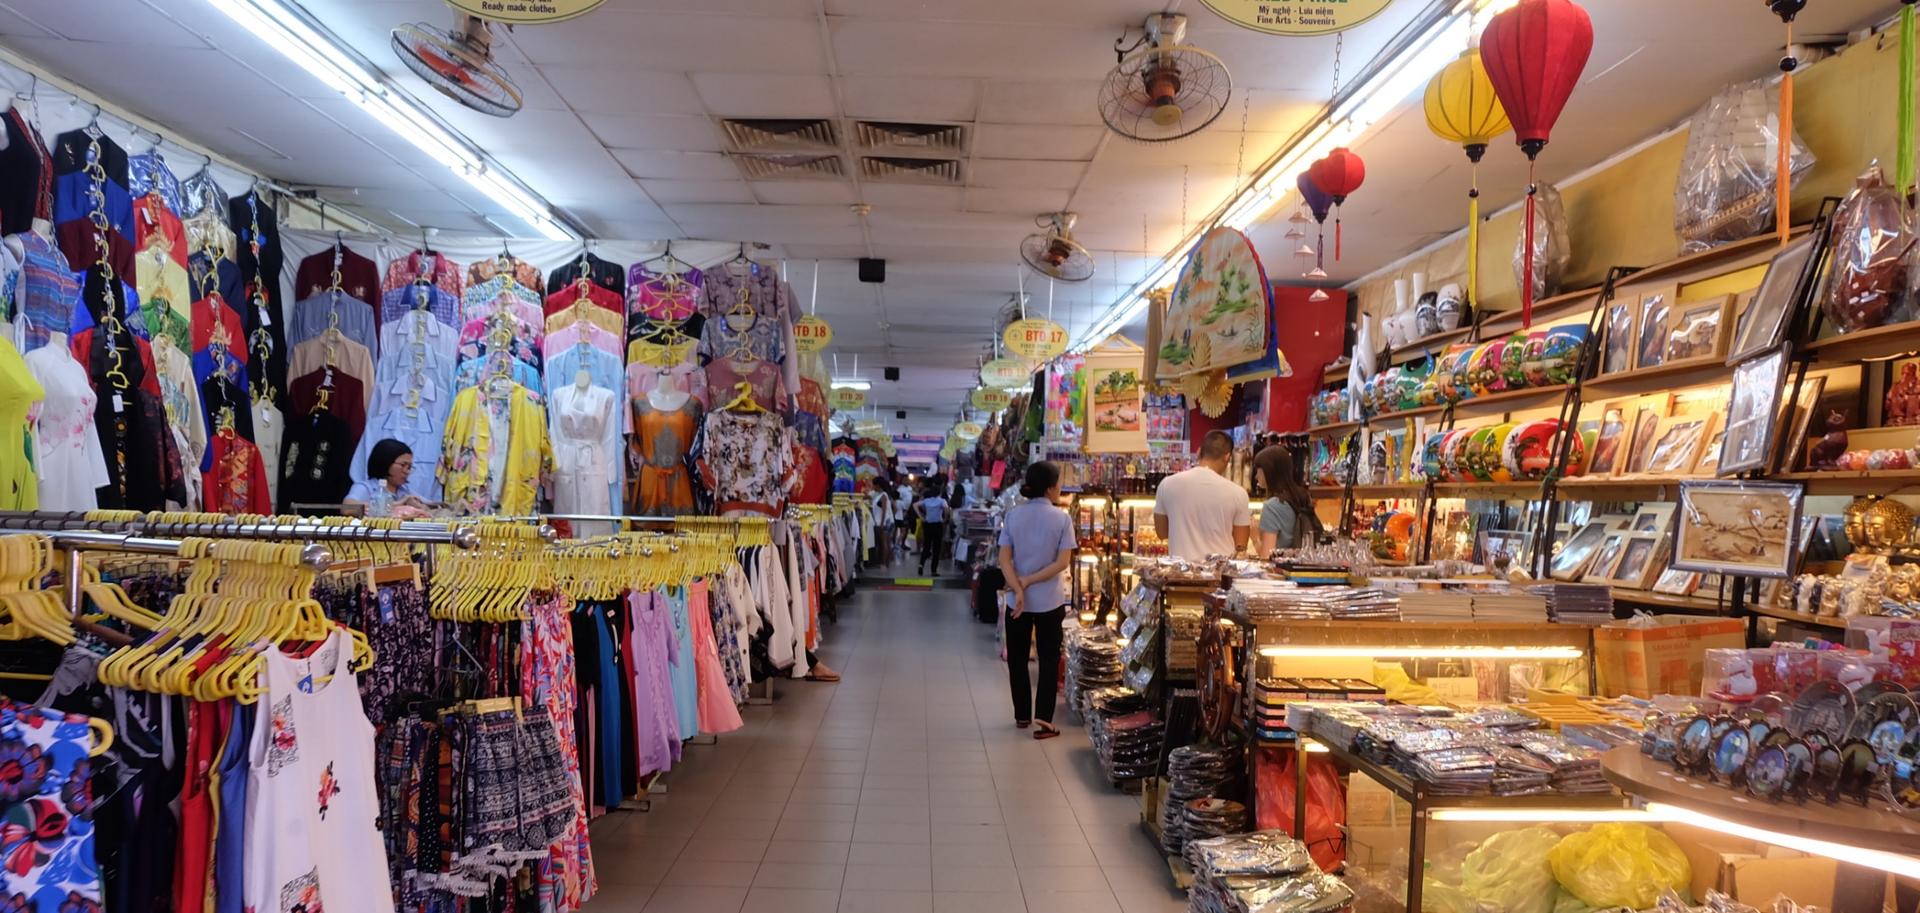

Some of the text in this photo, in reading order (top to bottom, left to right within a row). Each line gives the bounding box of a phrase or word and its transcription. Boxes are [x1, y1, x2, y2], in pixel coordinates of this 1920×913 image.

[482, 1, 557, 13] Ready made clothes
[1257, 15, 1273, 24] Fine
[1275, 15, 1292, 25] Arts
[1299, 16, 1336, 26] Souvenirs
[814, 325, 826, 337] 18
[1051, 331, 1063, 343] 17
